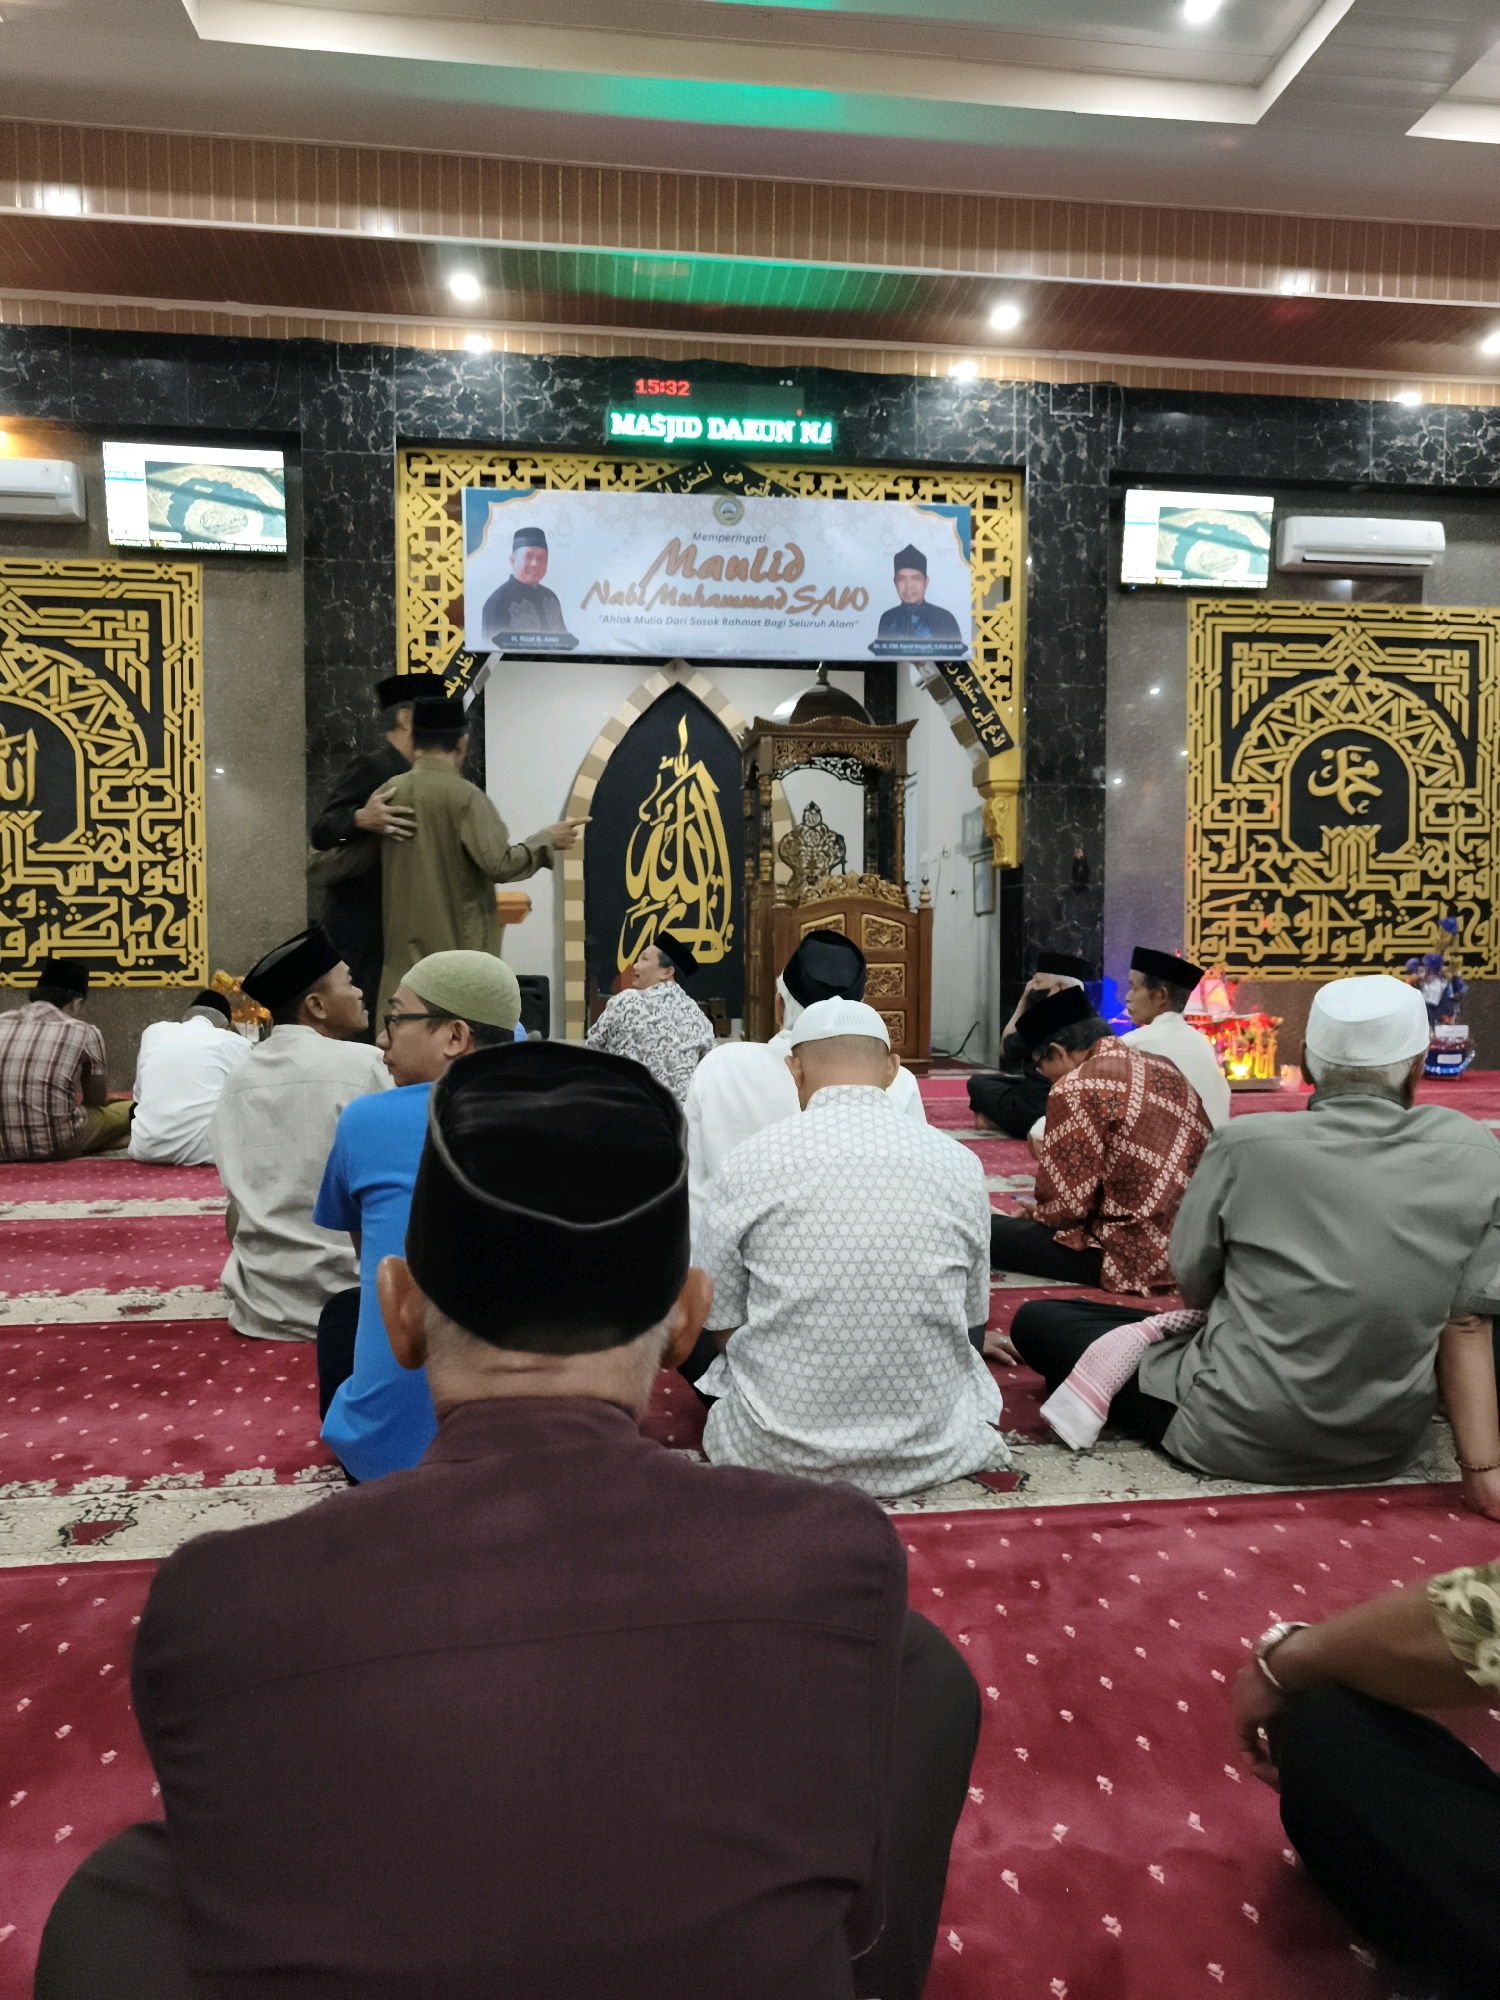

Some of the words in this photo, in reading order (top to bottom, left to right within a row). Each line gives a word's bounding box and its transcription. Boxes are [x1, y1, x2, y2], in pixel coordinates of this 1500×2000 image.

[635, 378, 690, 397] 15:32
[610, 412, 703, 443] MASJID
[692, 532, 767, 546] Memperingati
[639, 537, 805, 588] Maulid
[580, 579, 647, 610] Nabi
[644, 582, 788, 612] Muhammad
[633, 615, 664, 625] Mulia
[665, 616, 688, 626] Dari
[689, 616, 720, 627] Sosok
[721, 617, 762, 628] Rahmat
[763, 618, 787, 630] Bagi
[788, 618, 827, 628] Seluruh
